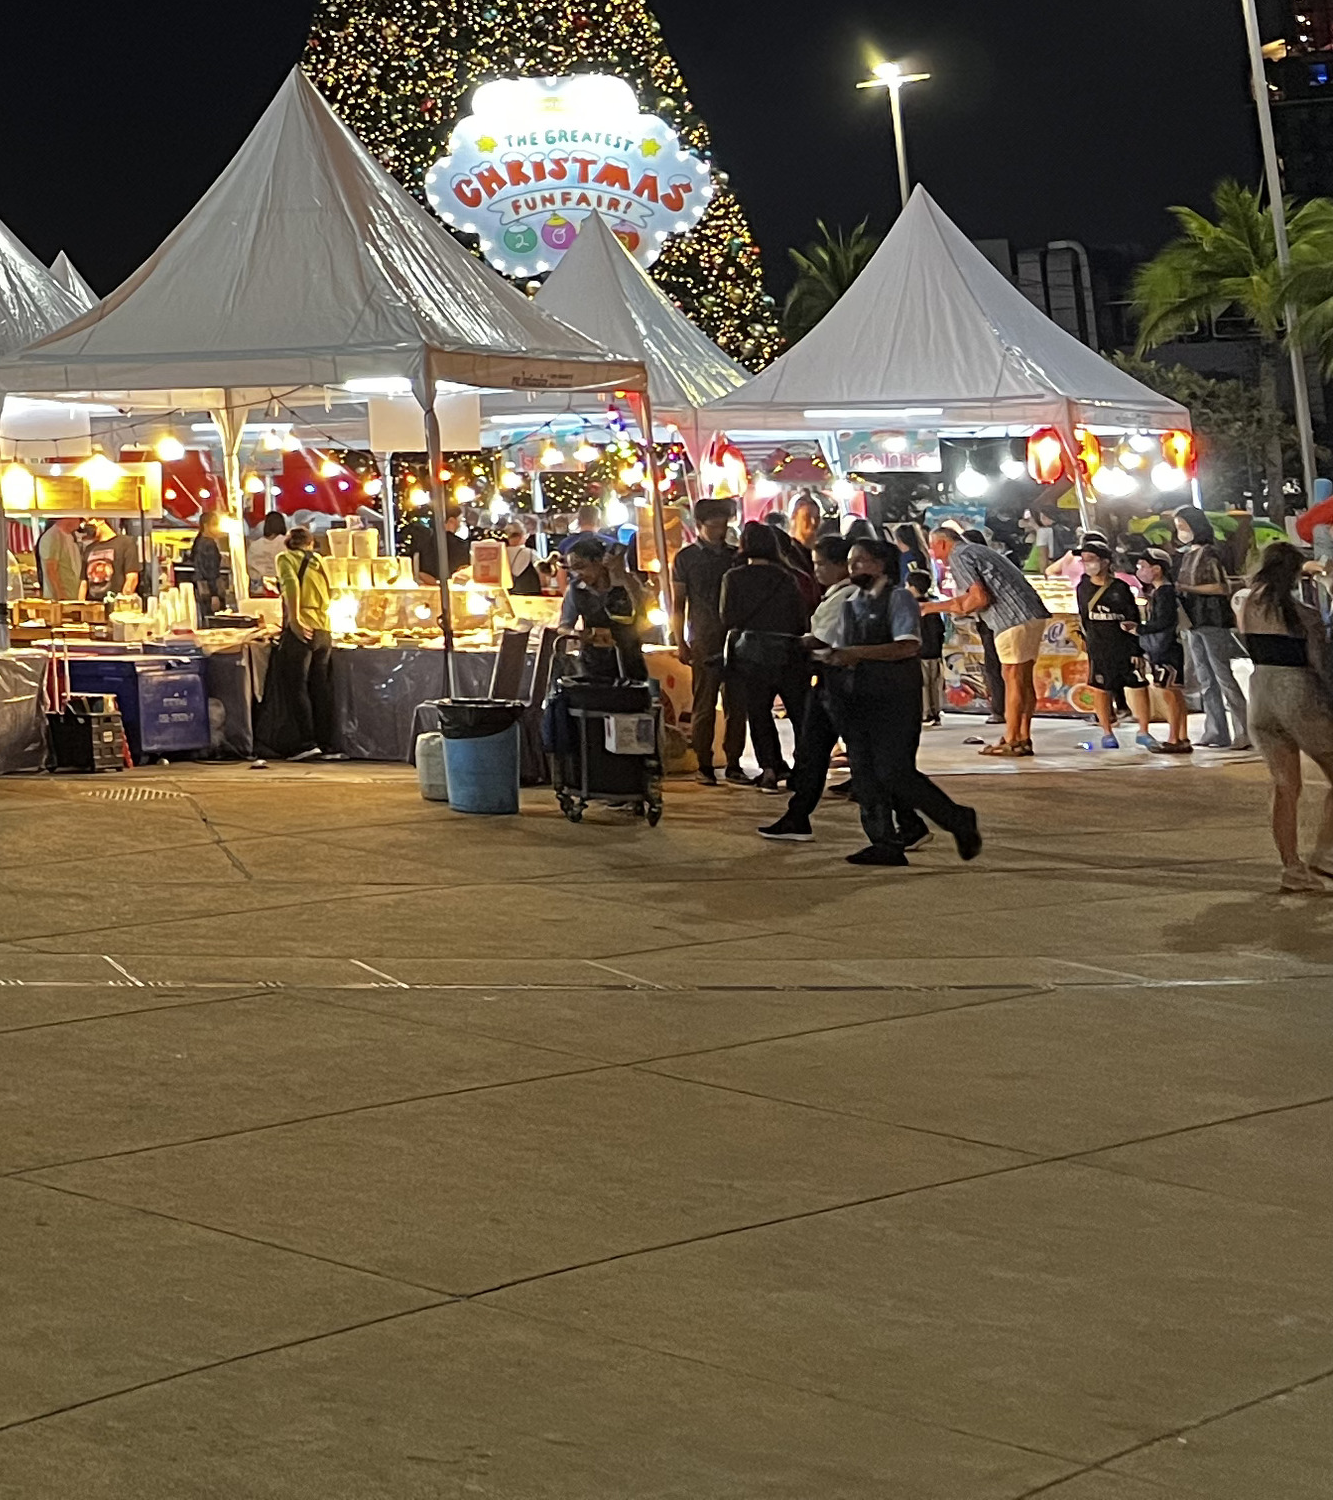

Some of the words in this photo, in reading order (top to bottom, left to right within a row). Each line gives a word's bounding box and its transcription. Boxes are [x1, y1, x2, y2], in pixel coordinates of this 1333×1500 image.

[505, 131, 538, 148] THE
[544, 129, 635, 152] GREATEST
[451, 151, 693, 213] CHRISTMAS
[510, 191, 633, 216] FUNFAIR!
